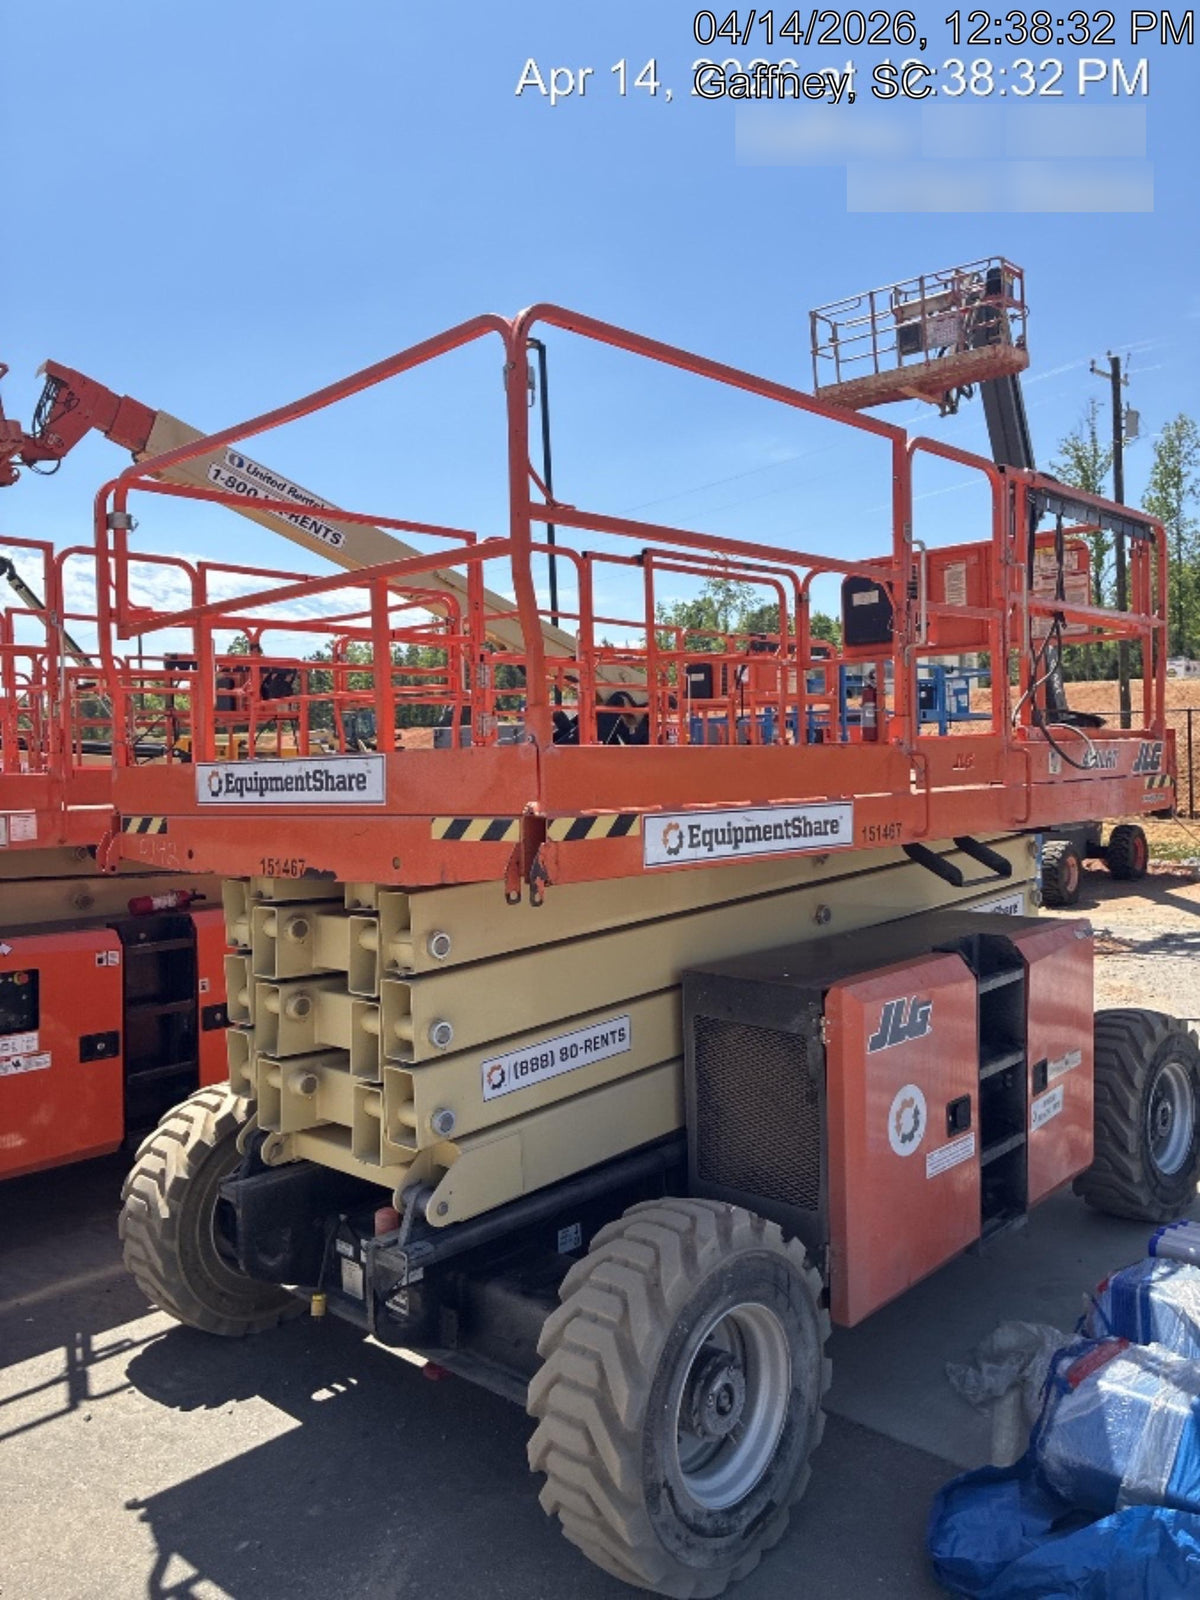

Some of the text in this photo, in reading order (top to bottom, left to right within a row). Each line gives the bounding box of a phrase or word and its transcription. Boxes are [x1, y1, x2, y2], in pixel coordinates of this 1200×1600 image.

[246, 463, 288, 492] United
[1132, 741, 1163, 773] JLG
[224, 769, 367, 797] EquipmentShare
[687, 816, 841, 853] EquipmentShare
[861, 822, 903, 842] 151467
[259, 858, 306, 878] 151467
[866, 995, 934, 1054] JLG
[513, 1027, 626, 1080] (888) 80-RENTS
